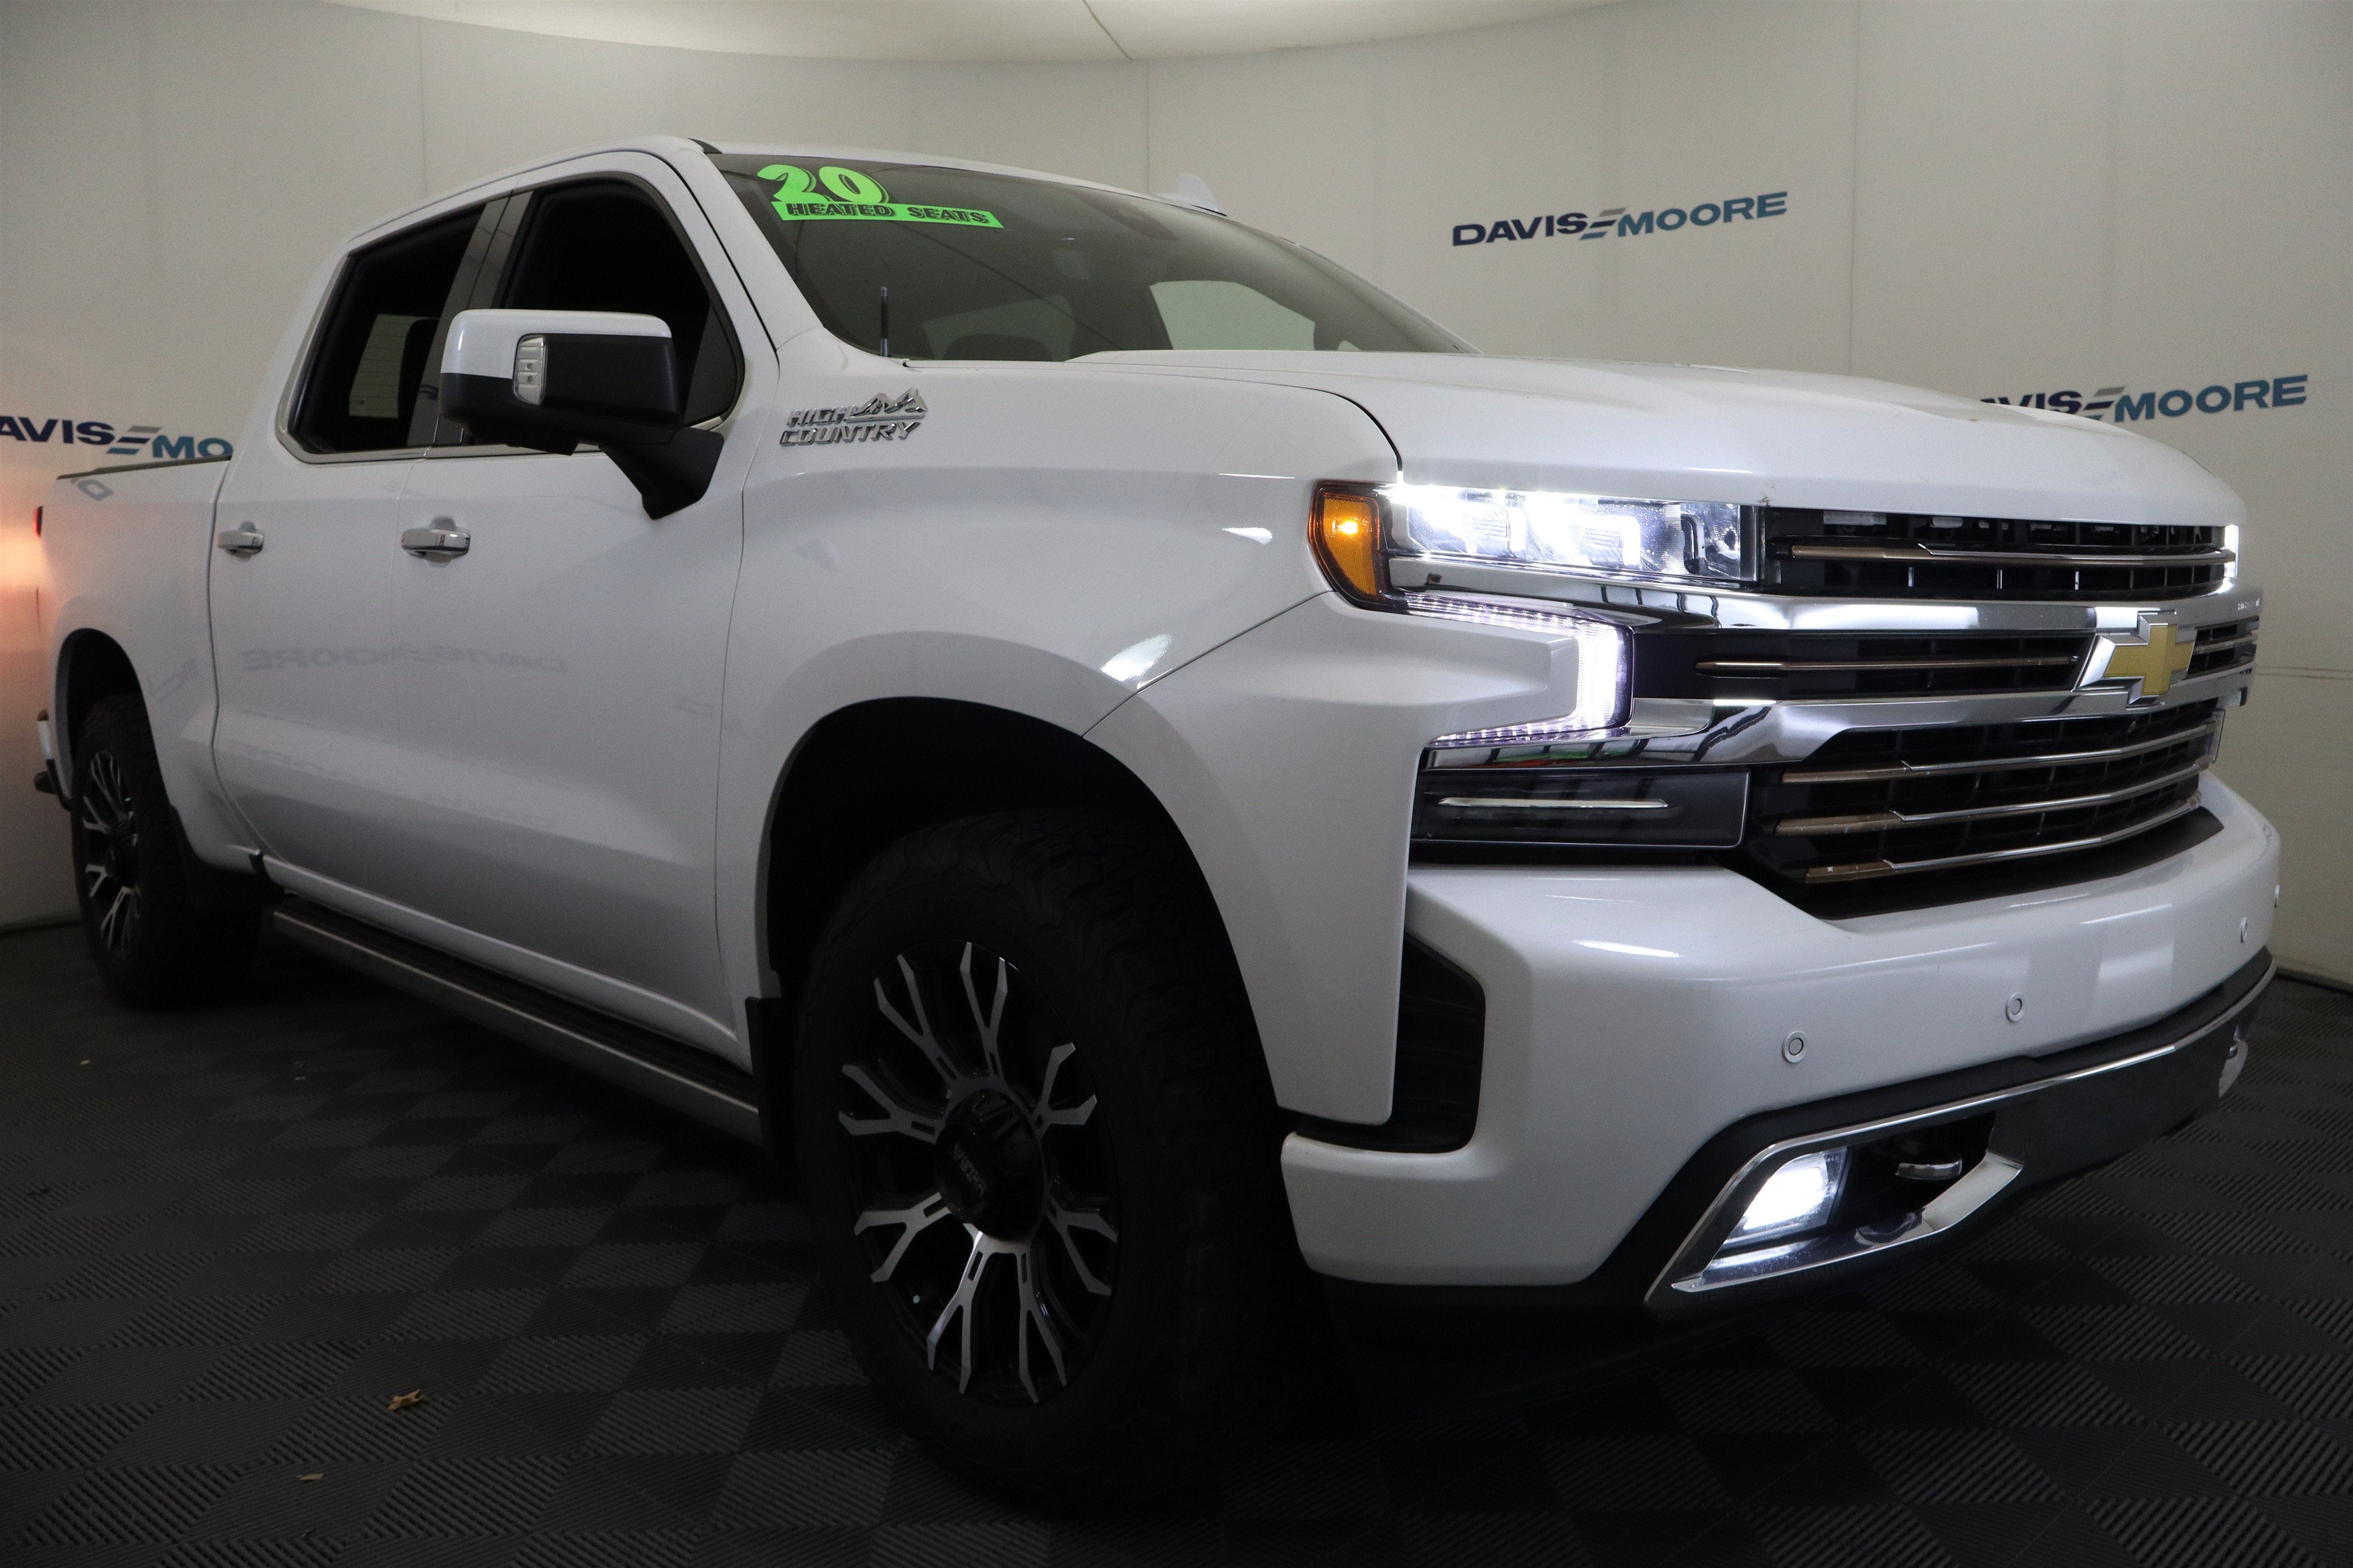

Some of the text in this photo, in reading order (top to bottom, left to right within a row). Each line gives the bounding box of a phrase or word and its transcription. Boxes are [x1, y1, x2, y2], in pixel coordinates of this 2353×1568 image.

[757, 164, 889, 203] 20
[786, 203, 990, 223] HEATED SEATS
[1452, 191, 1787, 246] DAVIS MOORE
[2115, 374, 2308, 422] MOORE
[786, 405, 858, 427] HIGH
[780, 422, 921, 446] COUNTRY
